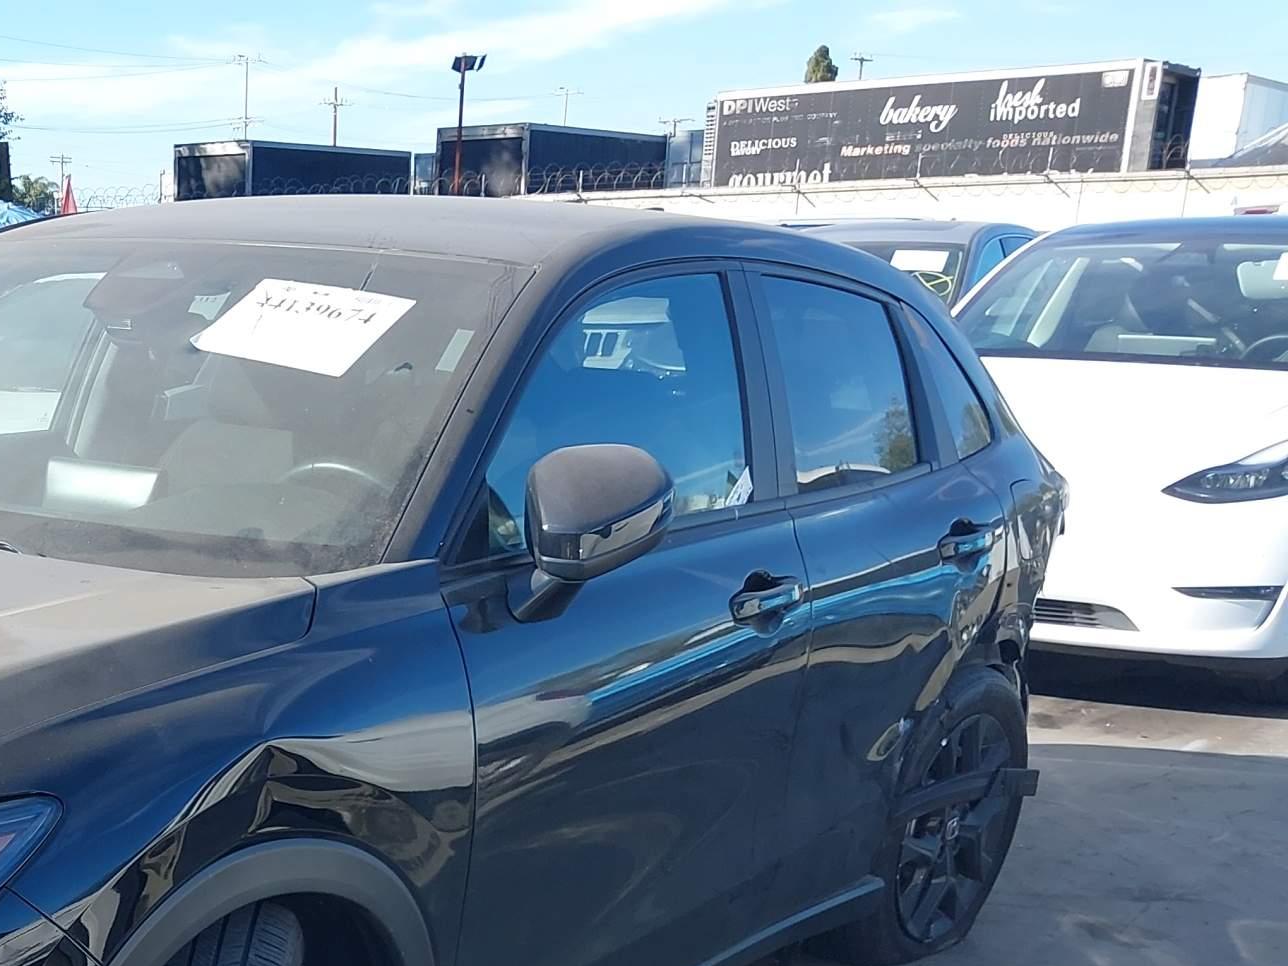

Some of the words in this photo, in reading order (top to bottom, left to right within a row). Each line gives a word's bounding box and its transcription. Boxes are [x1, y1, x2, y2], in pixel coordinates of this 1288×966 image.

[879, 94, 959, 133] bakery
[990, 98, 1081, 124] imported
[730, 137, 797, 151] DELICIOUS
[840, 143, 911, 157] Marketing
[1032, 132, 1119, 146] nationwide
[1003, 131, 1055, 140] DELICIOUS
